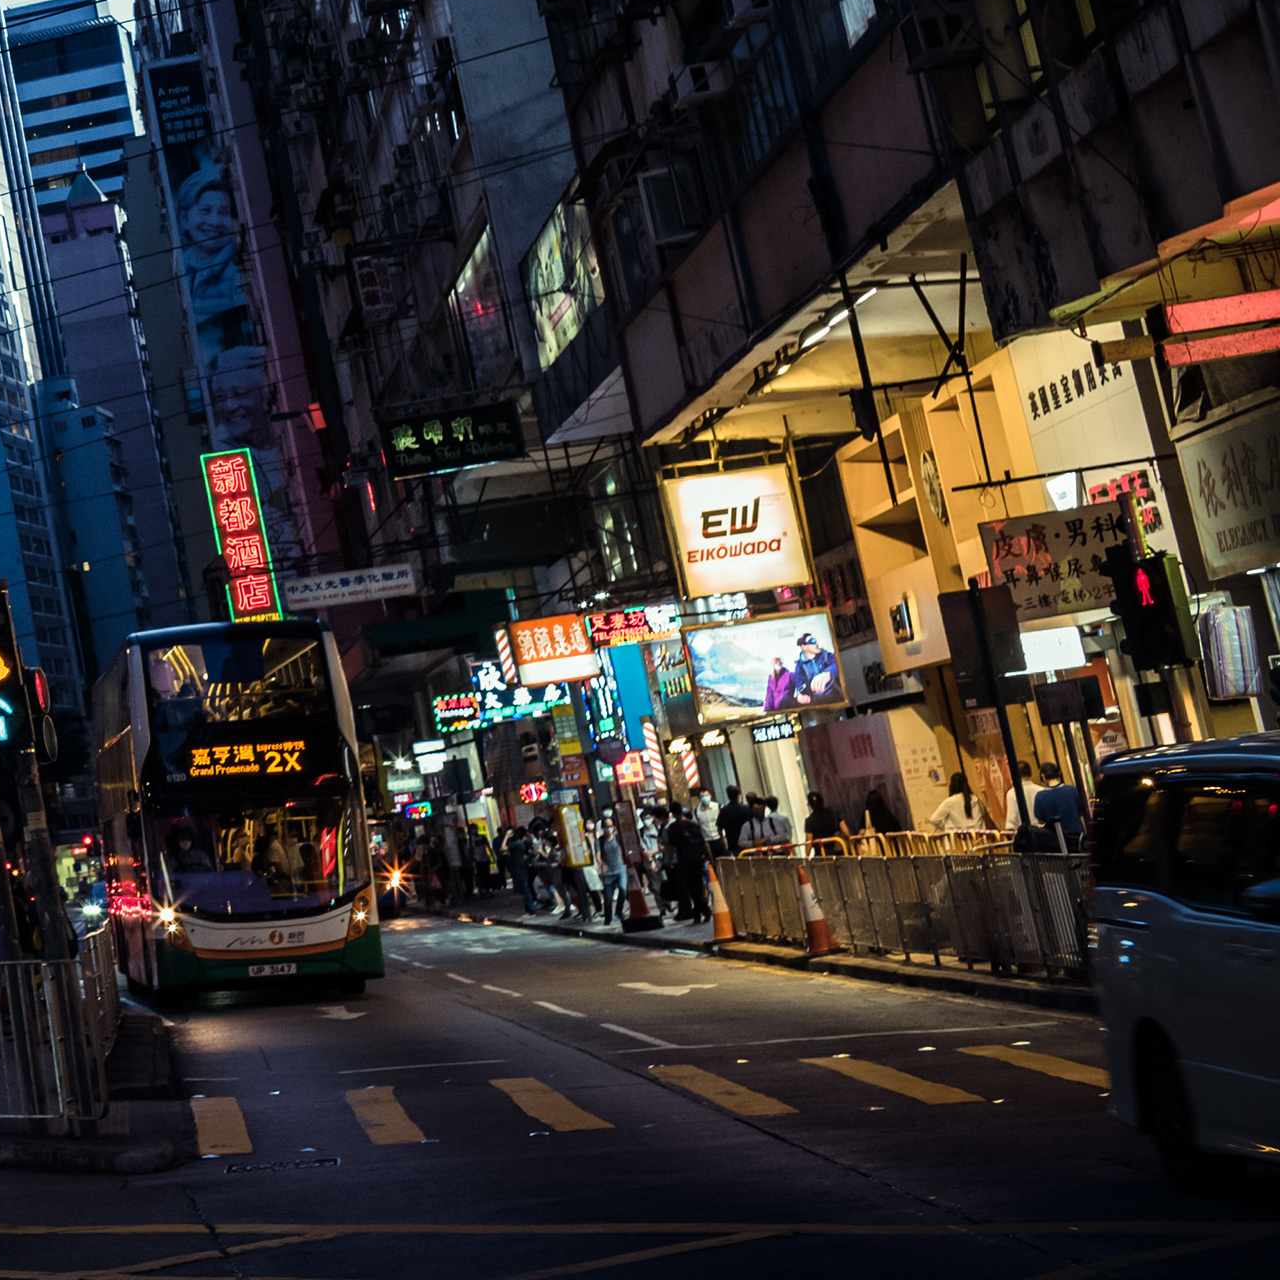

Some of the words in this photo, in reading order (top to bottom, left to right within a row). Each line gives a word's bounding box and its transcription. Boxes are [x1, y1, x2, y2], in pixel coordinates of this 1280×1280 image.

[700, 496, 761, 539] EW
[209, 456, 272, 612] 新都酒店
[517, 620, 588, 661] 頭頭是道
[190, 766, 214, 777] Grand
[215, 763, 260, 775] Promenade
[264, 751, 302, 773] 2X
[252, 968, 266, 976] UP
[270, 964, 293, 974] 3147
